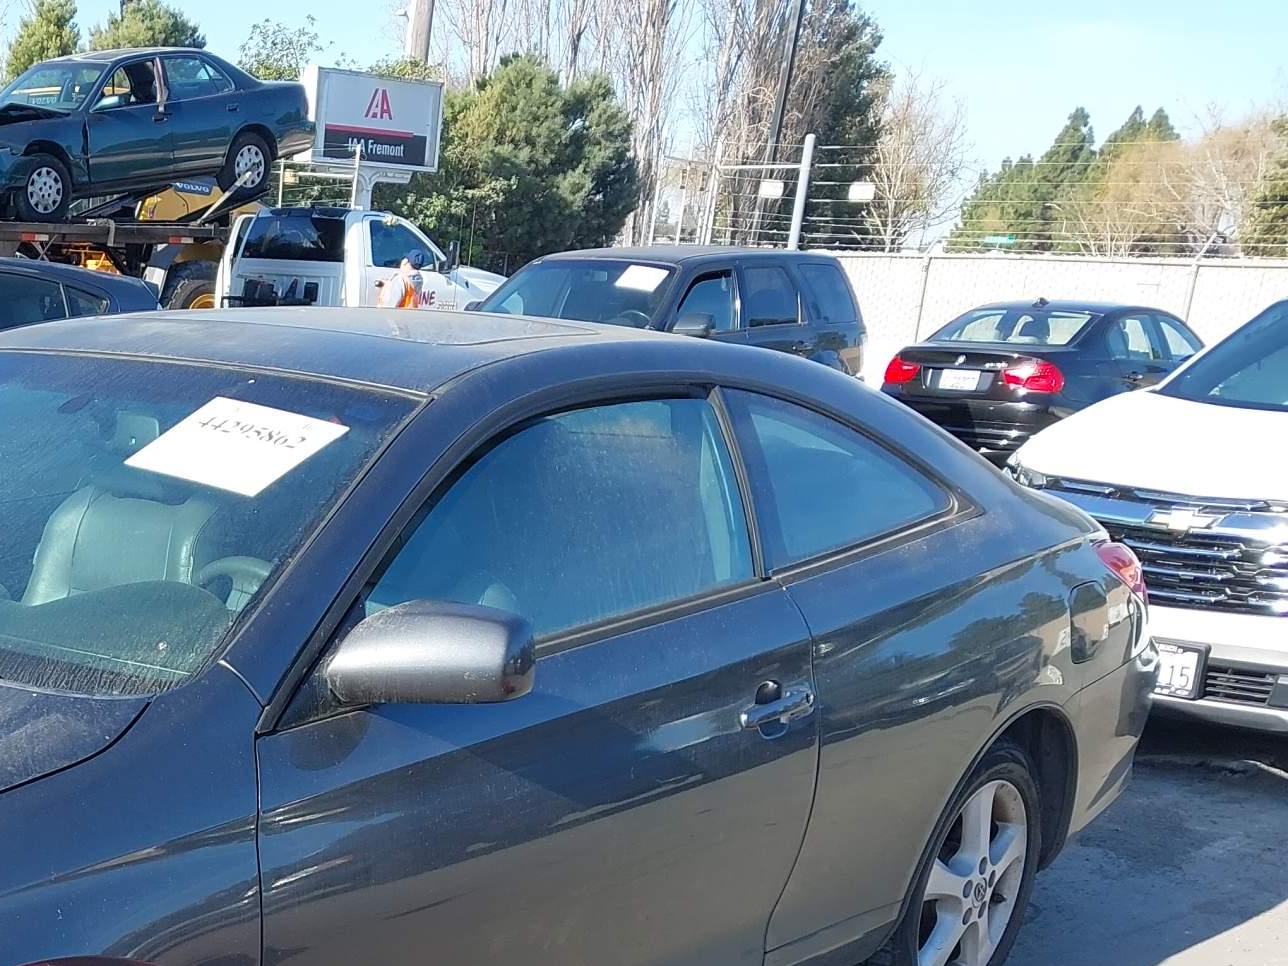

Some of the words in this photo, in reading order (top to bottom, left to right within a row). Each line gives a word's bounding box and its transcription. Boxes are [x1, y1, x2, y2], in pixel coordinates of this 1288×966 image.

[368, 139, 404, 157] Fremont
[175, 182, 210, 193] VOLVO
[198, 416, 307, 449] 44295862
